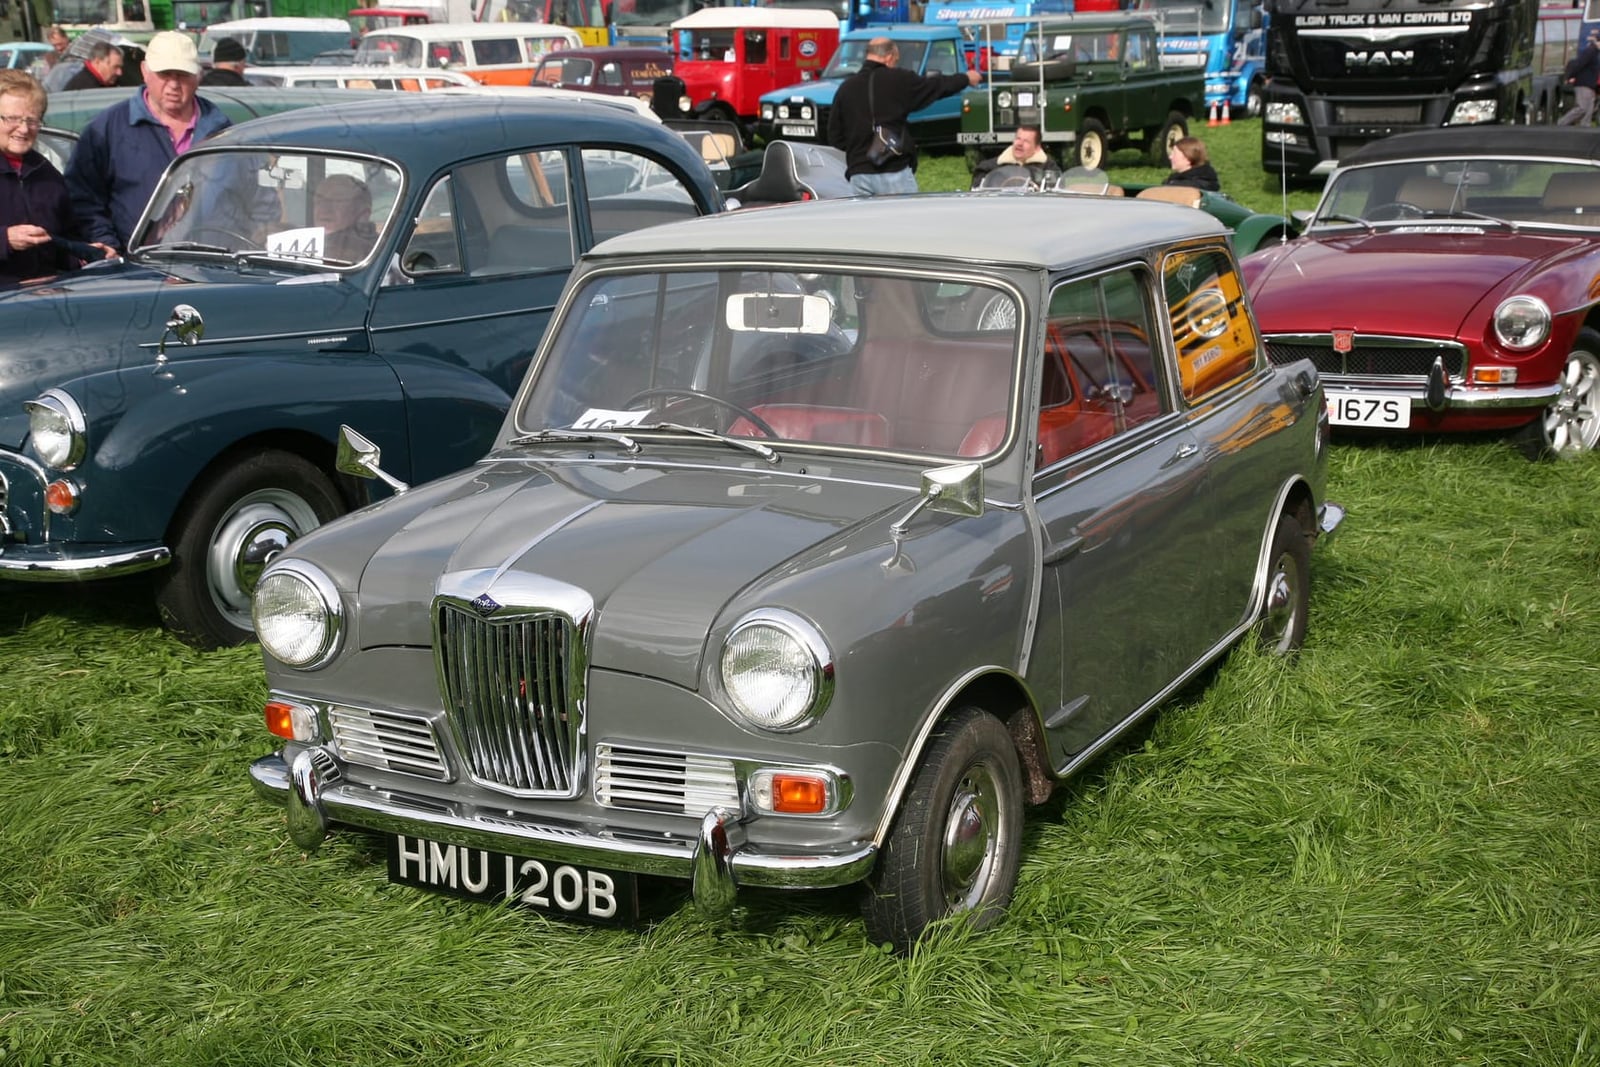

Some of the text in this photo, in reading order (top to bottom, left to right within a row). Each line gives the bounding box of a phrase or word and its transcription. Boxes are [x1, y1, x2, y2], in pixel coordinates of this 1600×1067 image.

[1295, 11, 1472, 26] ELGIN TRUCK & VAN CENTRE LTD
[1345, 50, 1415, 67] MAN
[1337, 398, 1400, 423] 167S
[397, 834, 618, 919] HMU 120B
